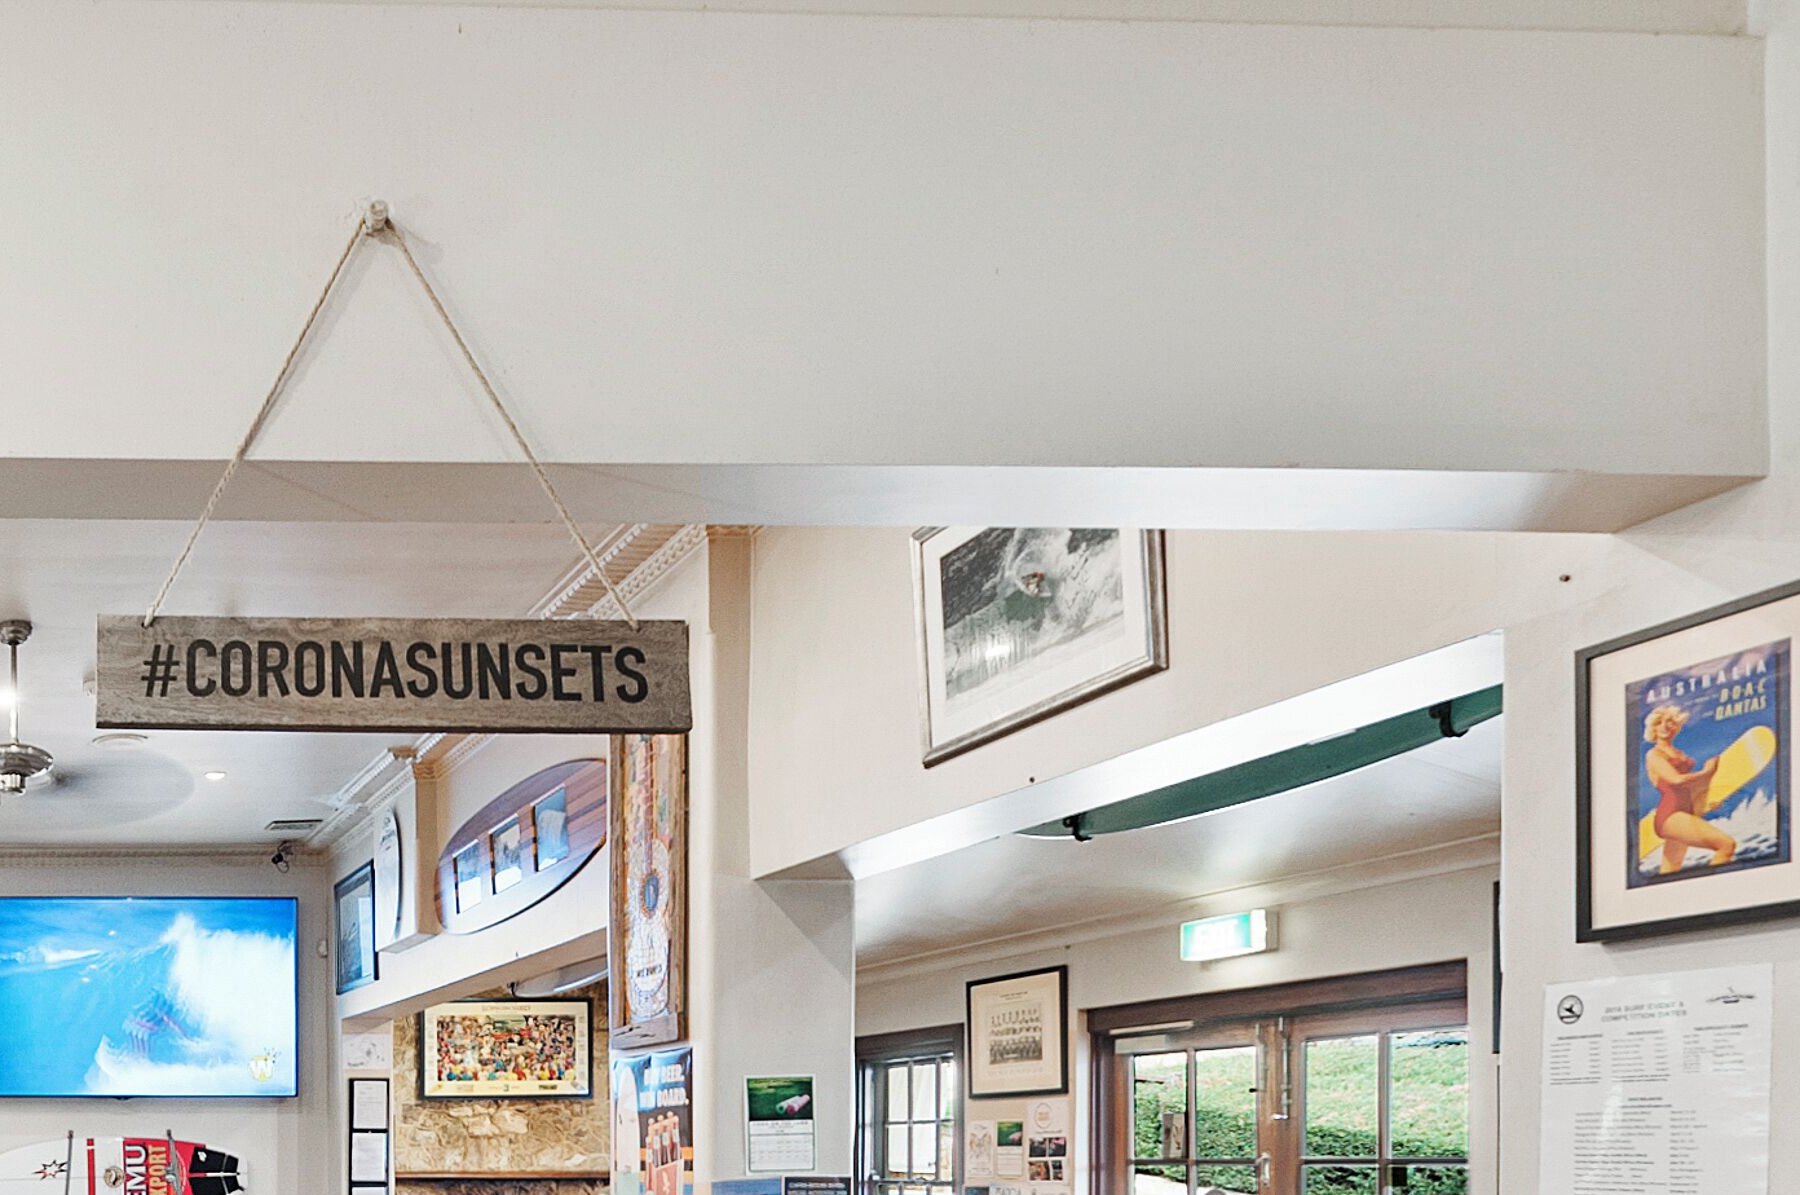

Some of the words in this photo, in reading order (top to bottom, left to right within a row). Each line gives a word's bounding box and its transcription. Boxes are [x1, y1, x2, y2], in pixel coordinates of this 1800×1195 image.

[140, 638, 649, 703] #CORONASUNSETS
[1646, 659, 1767, 703] AUSTRALIA
[1715, 695, 1767, 721] QANTAS
